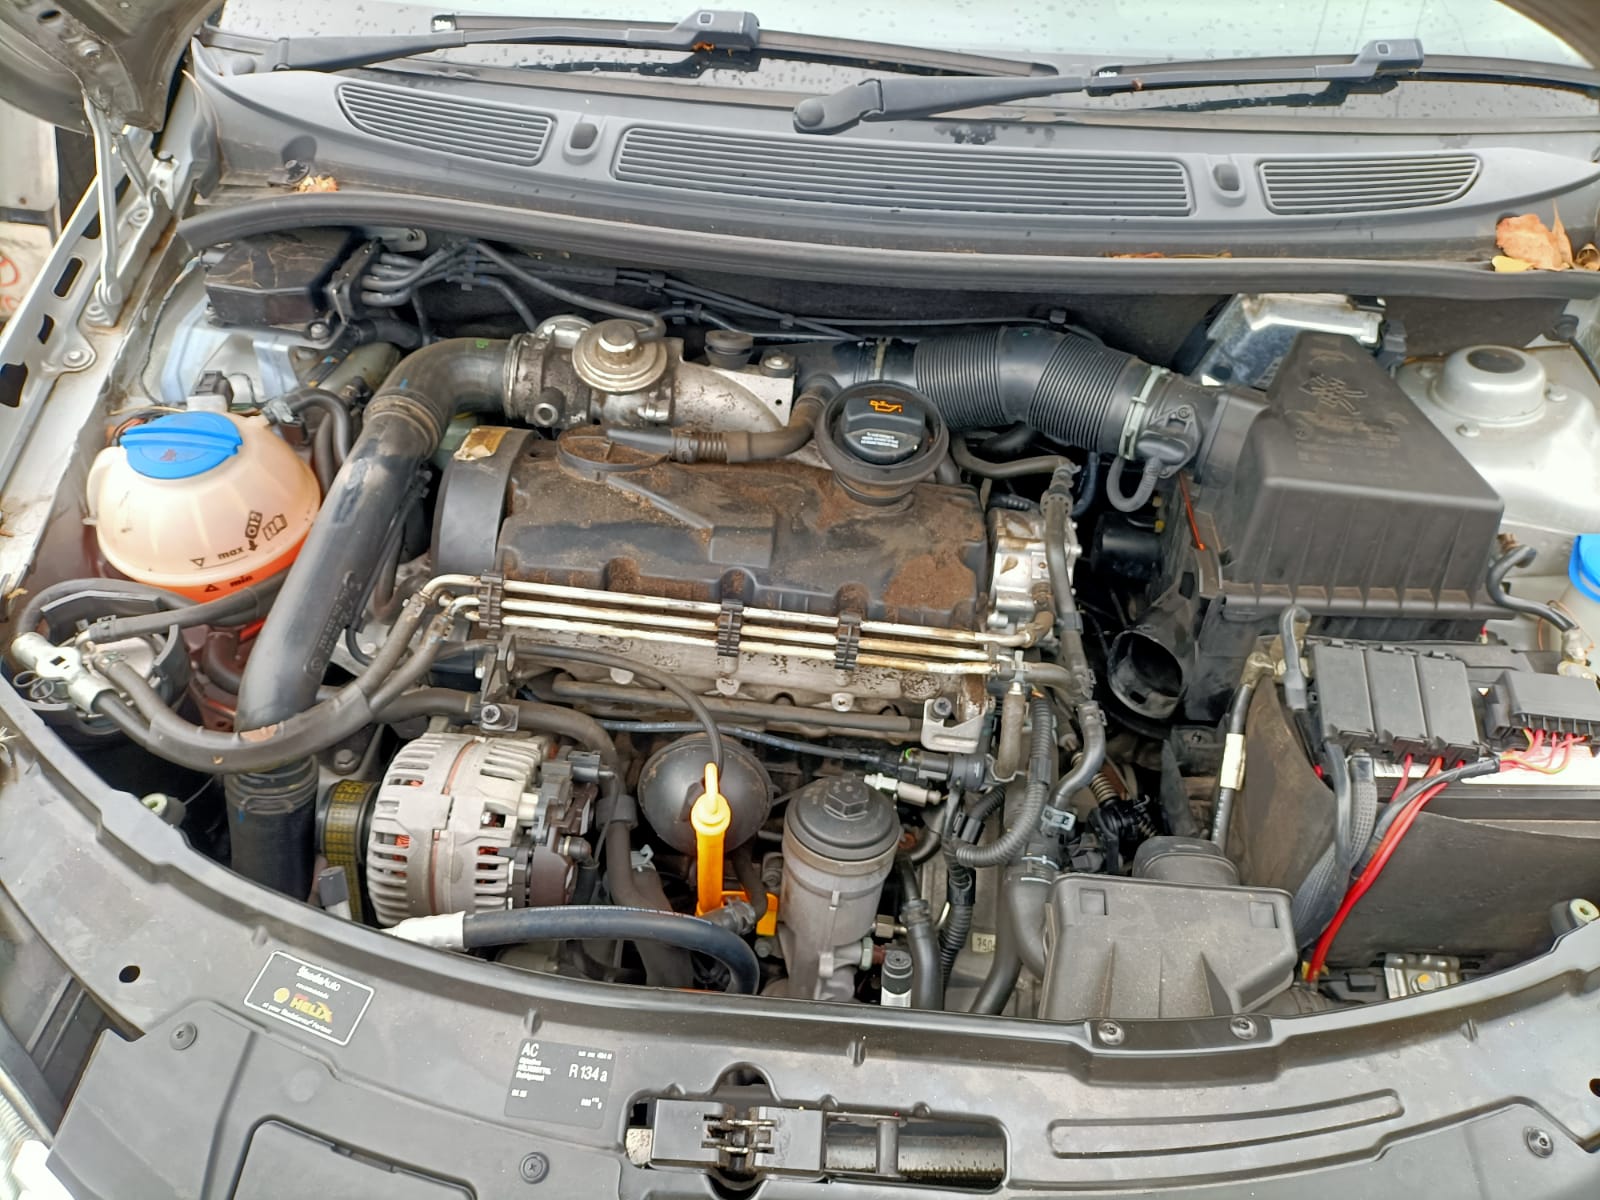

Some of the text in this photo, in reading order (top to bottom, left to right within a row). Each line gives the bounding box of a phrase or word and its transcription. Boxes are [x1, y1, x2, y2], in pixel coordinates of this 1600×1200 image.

[218, 547, 243, 559] max
[229, 575, 253, 587] min
[290, 997, 332, 1023] HELIX
[521, 1042, 539, 1057] AC
